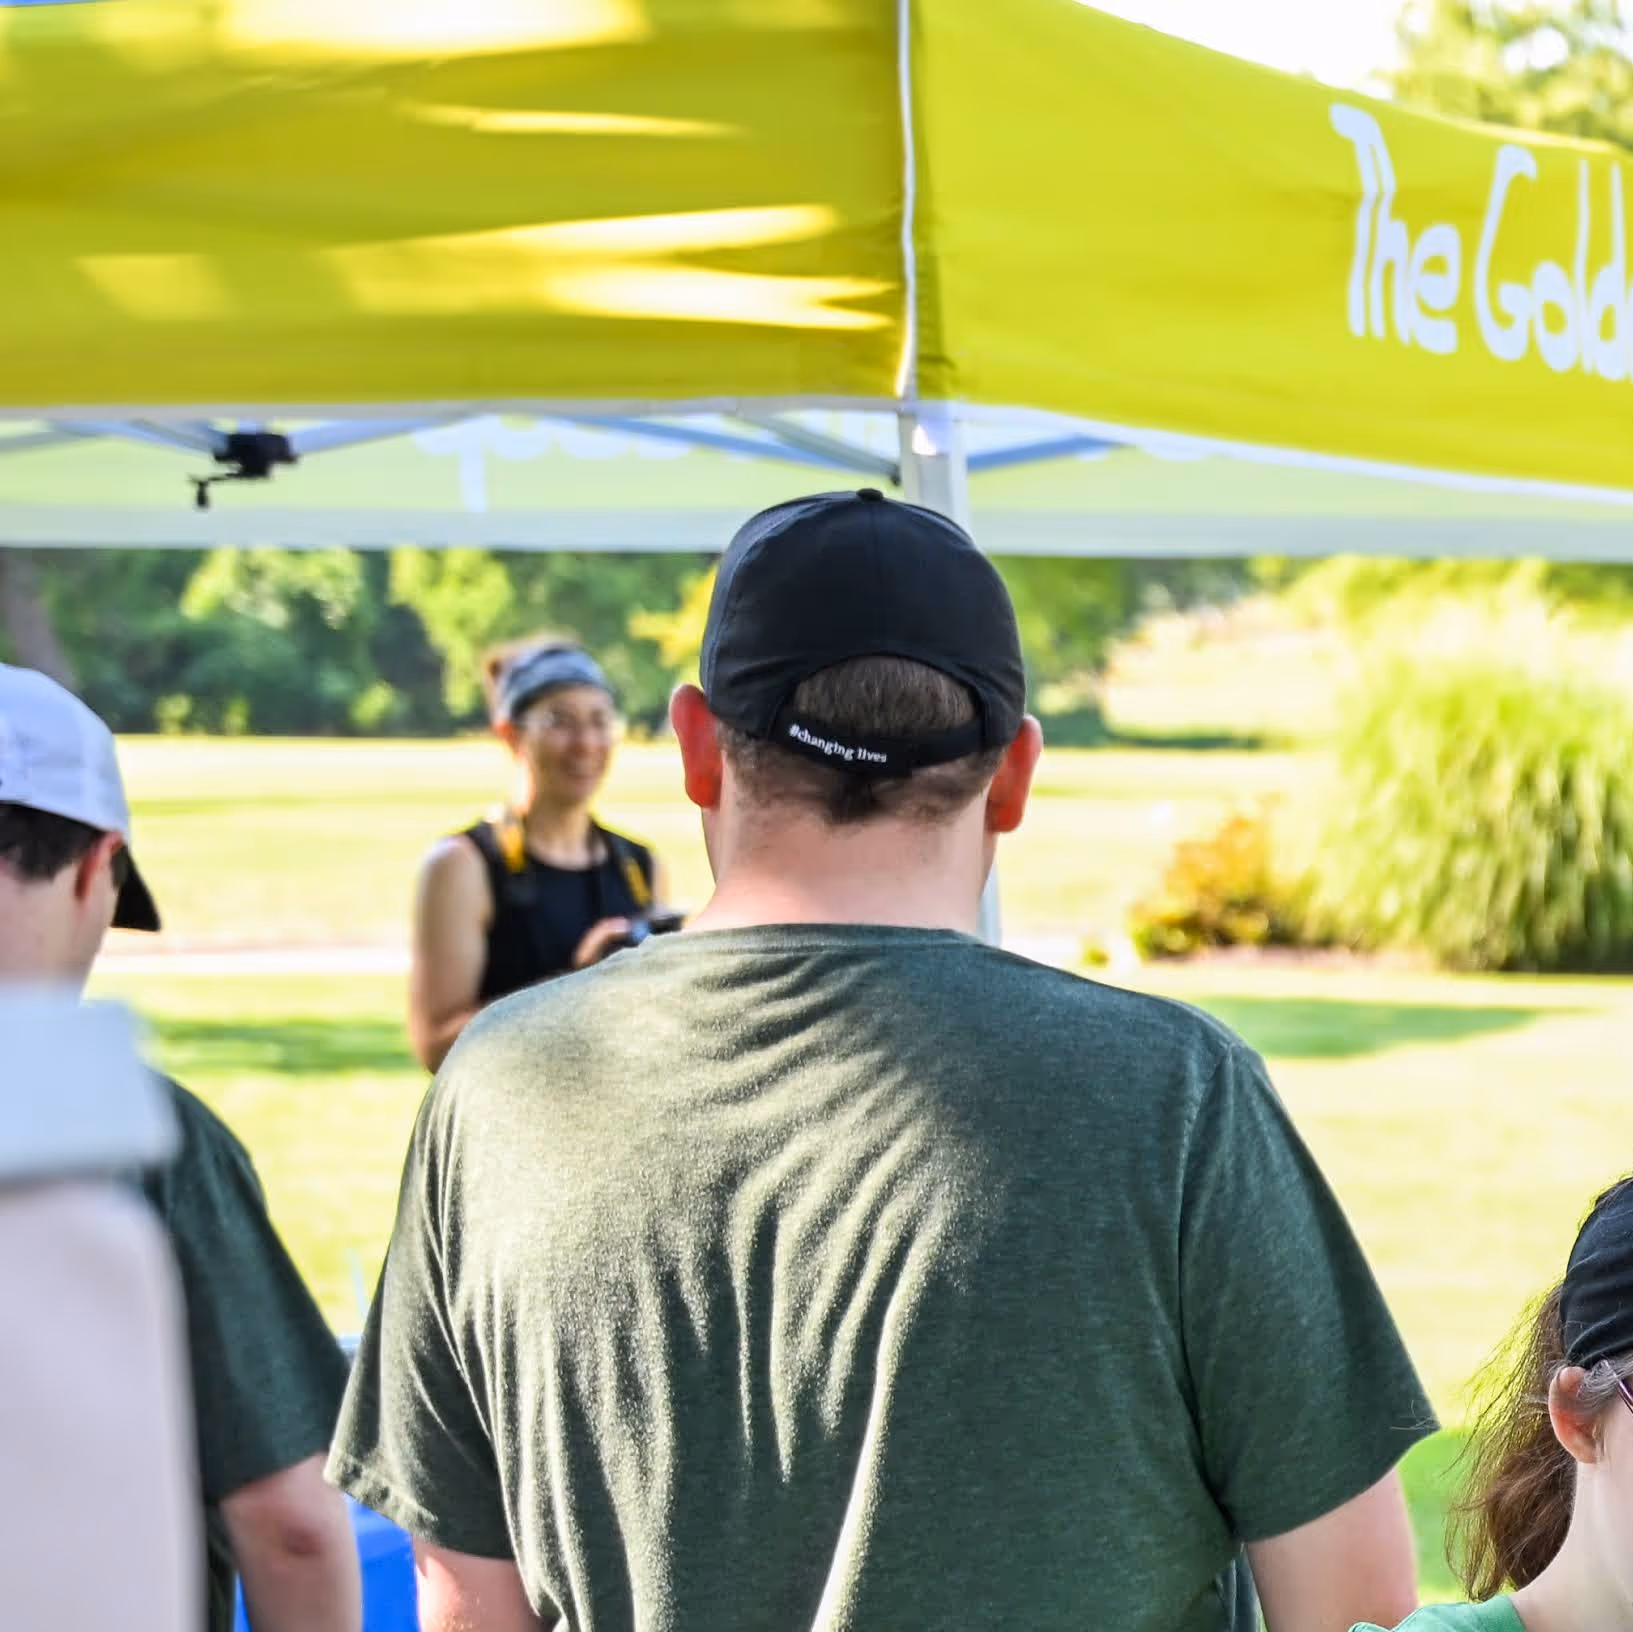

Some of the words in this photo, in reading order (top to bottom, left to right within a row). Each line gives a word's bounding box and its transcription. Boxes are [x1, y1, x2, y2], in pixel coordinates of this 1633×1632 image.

[1329, 103, 1462, 355] The
[789, 723, 855, 761] #changing
[857, 748, 888, 763] lives
